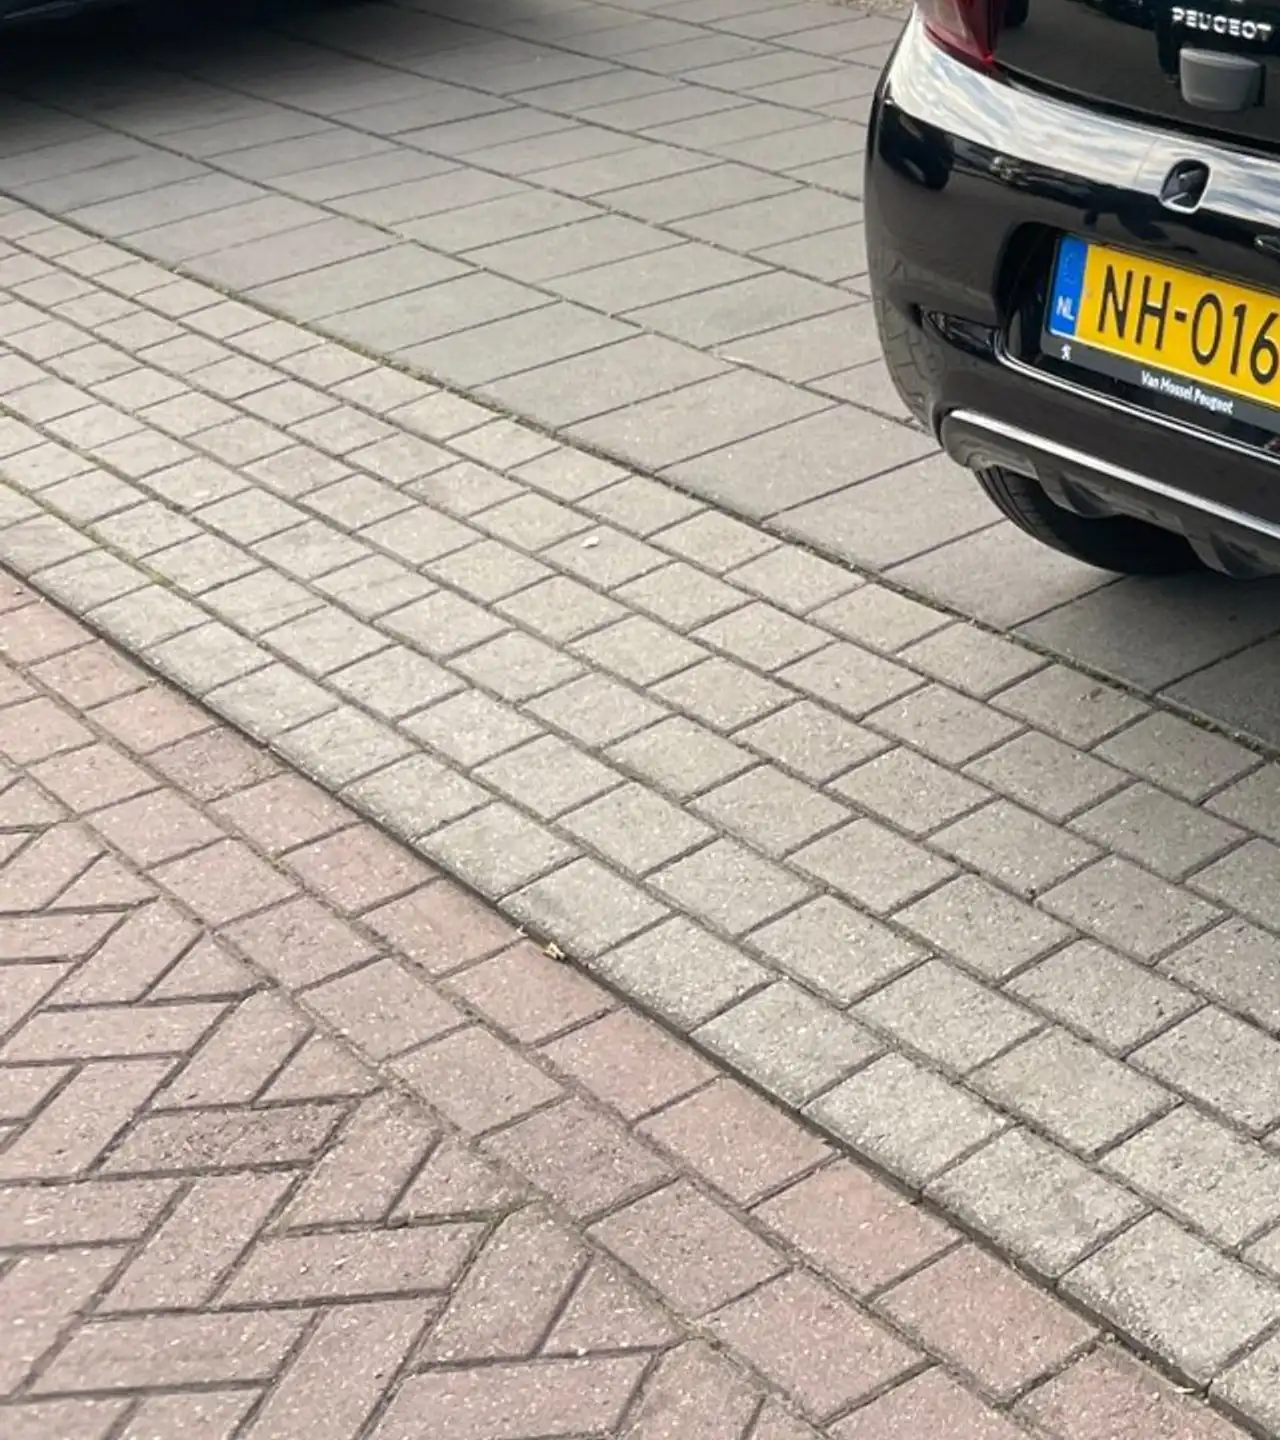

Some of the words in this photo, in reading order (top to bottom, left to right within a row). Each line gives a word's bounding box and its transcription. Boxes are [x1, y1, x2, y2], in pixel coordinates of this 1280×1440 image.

[1171, 6, 1272, 42] PEUGEOT
[1056, 295, 1076, 321] NL
[1141, 369, 1159, 389] Van
[1160, 375, 1194, 402] Mossel
[1194, 387, 1234, 416] Peugeot
